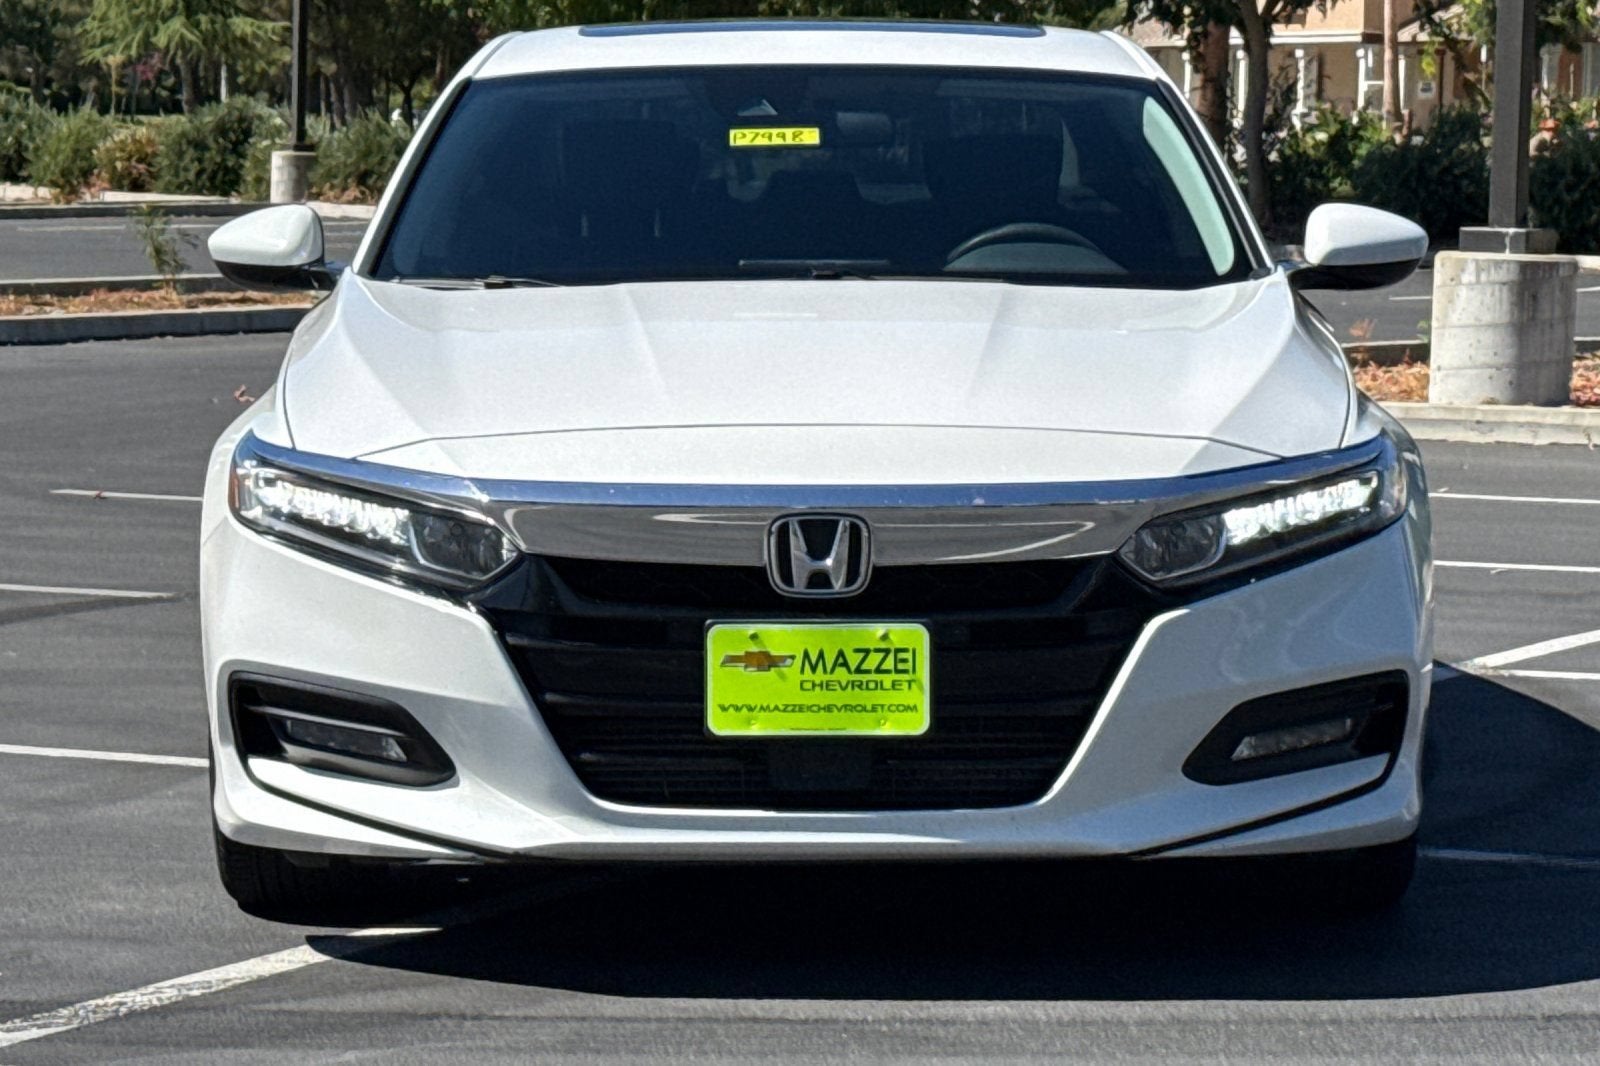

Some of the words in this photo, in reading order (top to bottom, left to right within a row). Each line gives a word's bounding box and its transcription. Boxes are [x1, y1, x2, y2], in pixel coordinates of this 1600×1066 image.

[799, 647, 917, 675] MAZZEI
[799, 679, 915, 692] CHEVROLET
[718, 703, 918, 714] WWW.MAZZEICHEVROLET.COM
